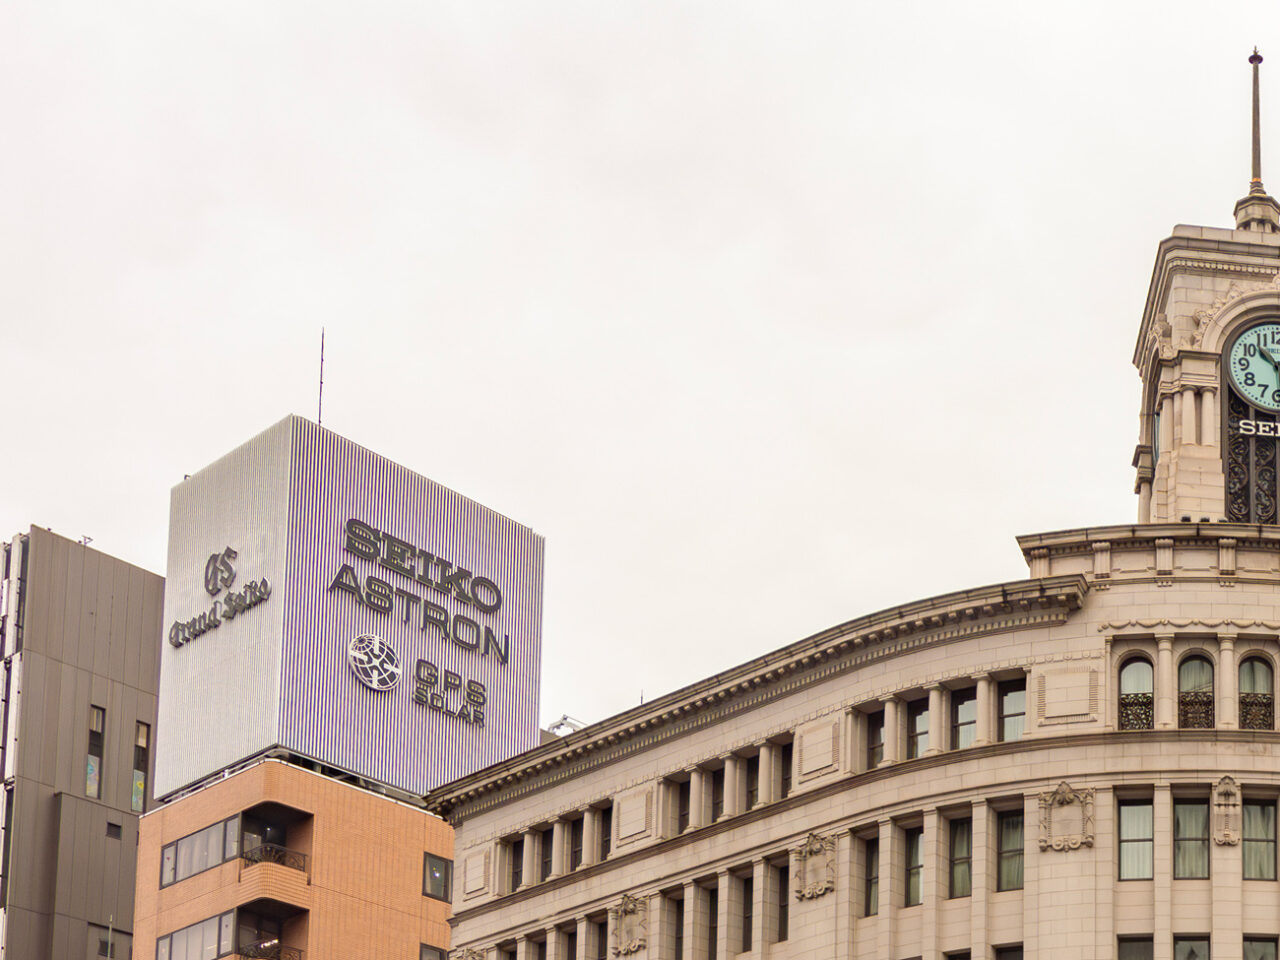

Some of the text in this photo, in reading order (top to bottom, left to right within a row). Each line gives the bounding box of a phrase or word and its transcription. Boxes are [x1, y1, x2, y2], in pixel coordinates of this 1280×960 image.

[1243, 343, 1256, 357] 10
[1256, 333, 1267, 347] 11
[1238, 357, 1250, 371] 9
[1244, 372, 1256, 386] 8
[1257, 384, 1269, 398] 7
[345, 518, 502, 614] SEIKO
[168, 576, 272, 649] Grand Seiko
[328, 563, 509, 667] ASTRON
[413, 658, 487, 706] GPS
[412, 684, 485, 728] SOLAR
